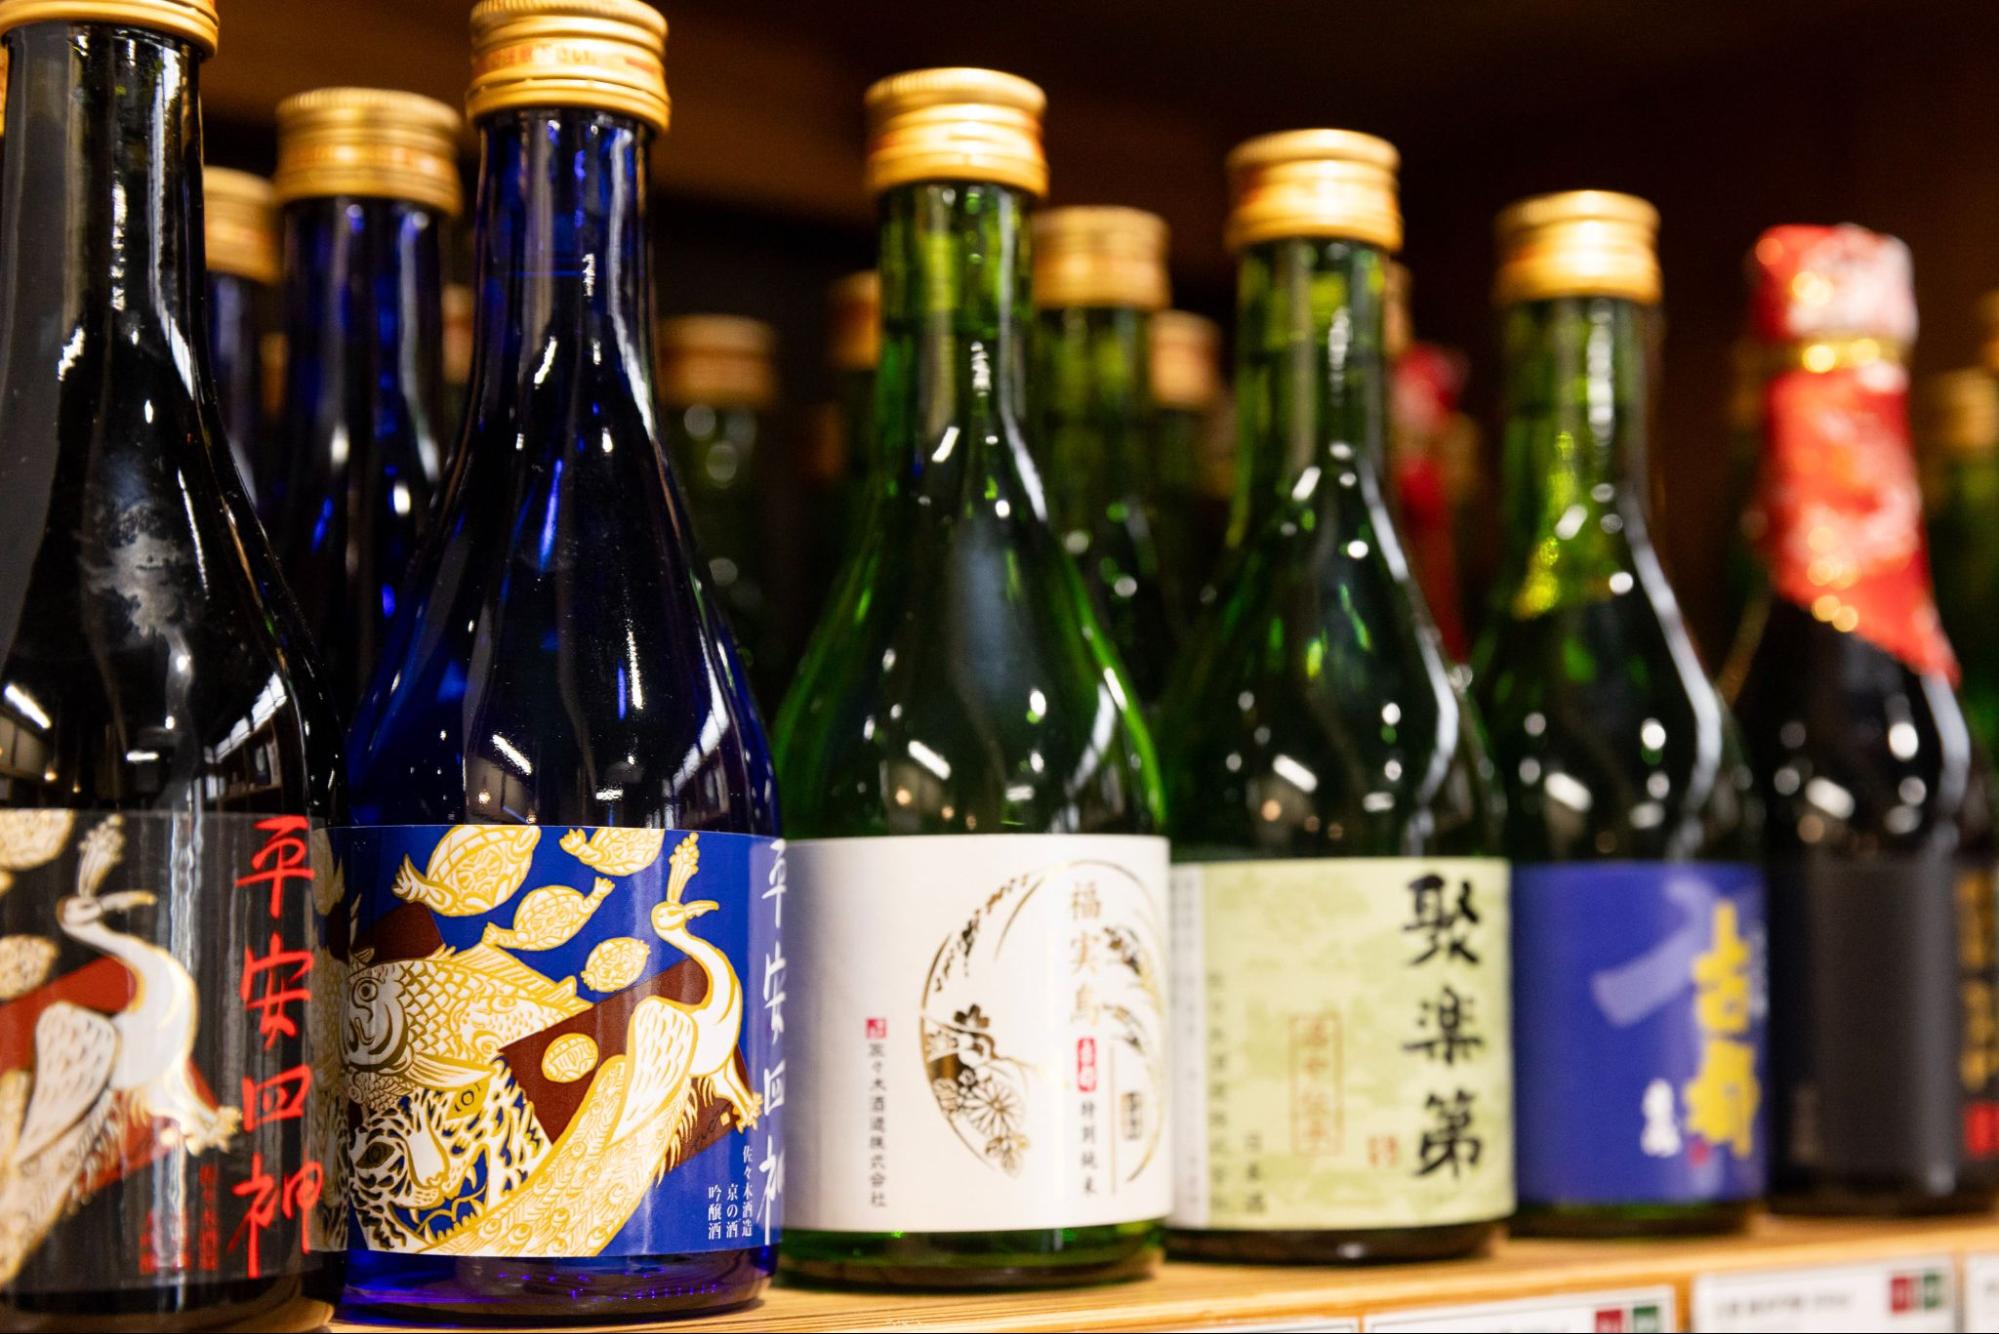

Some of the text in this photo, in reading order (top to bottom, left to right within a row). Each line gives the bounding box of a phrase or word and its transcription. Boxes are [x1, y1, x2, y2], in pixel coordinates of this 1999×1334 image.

[226, 814, 324, 1280] 平安四神
[1402, 872, 1484, 1180] 聚楽第
[707, 1183, 722, 1240] 吟醸酒
[726, 1182, 740, 1239] 京の酒
[742, 1144, 753, 1237] 佐々木酒造
